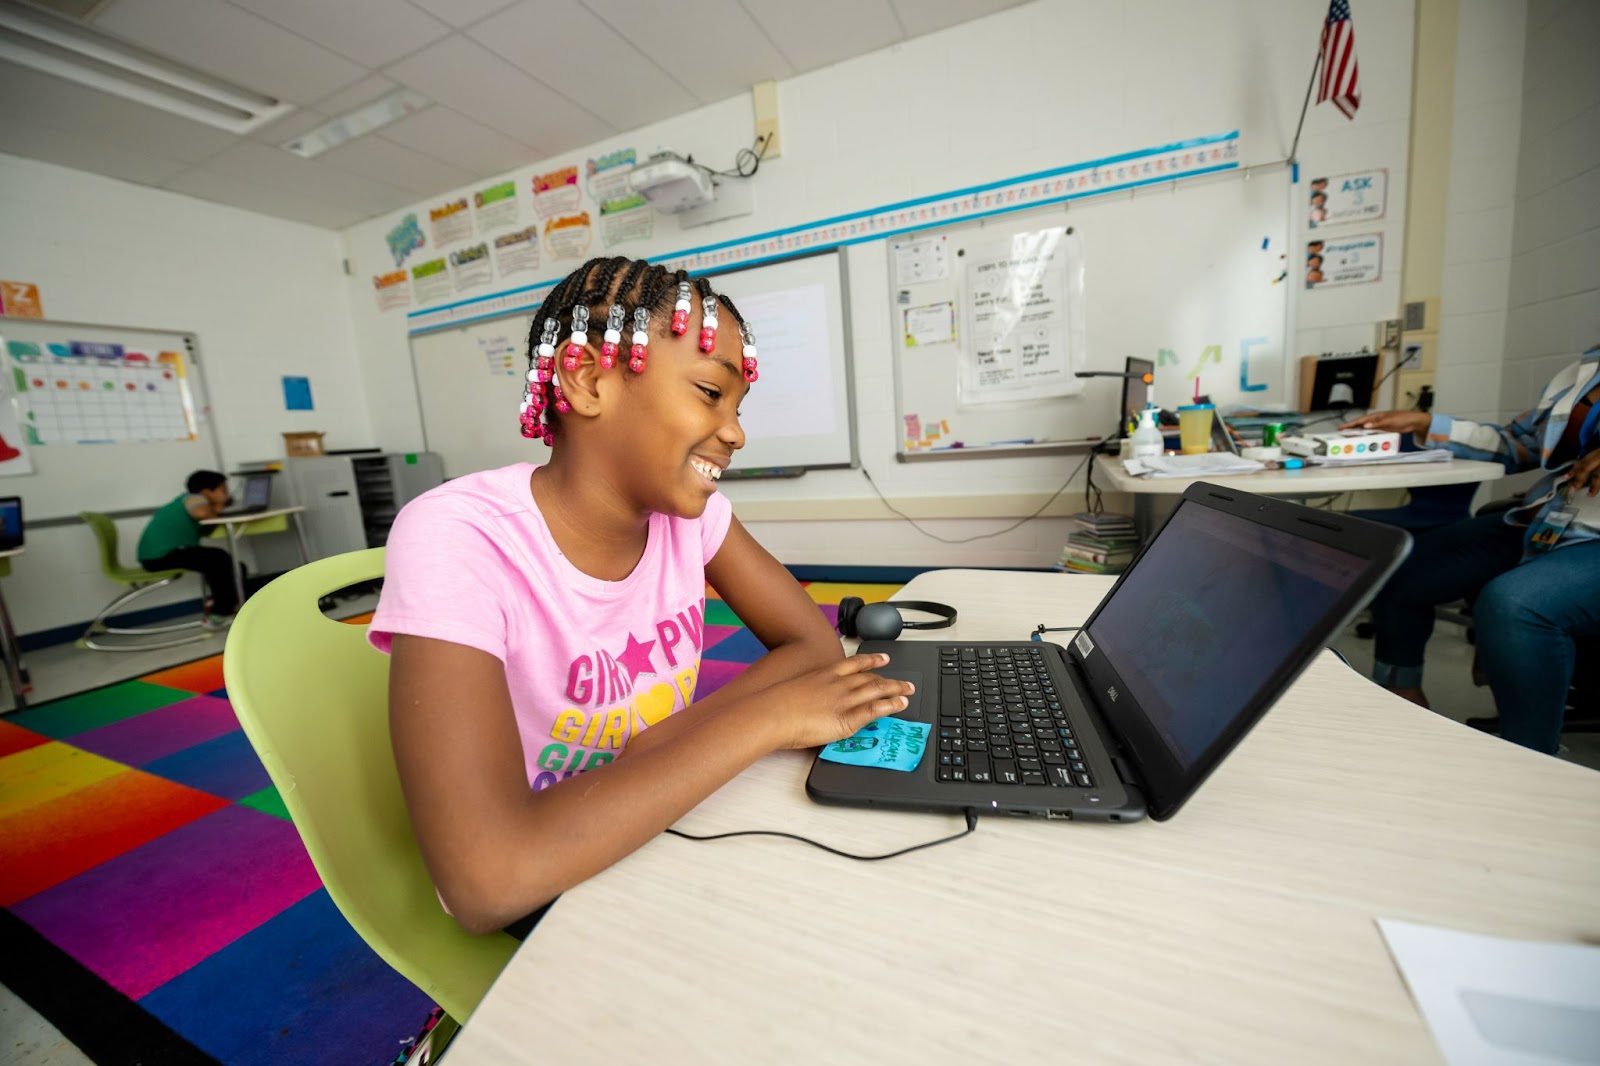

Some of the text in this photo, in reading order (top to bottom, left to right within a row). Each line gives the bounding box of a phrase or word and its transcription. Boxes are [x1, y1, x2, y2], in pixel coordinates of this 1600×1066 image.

[1342, 176, 1373, 192] ASK
[12, 284, 32, 304] Z
[1107, 686, 1118, 702] DELL
